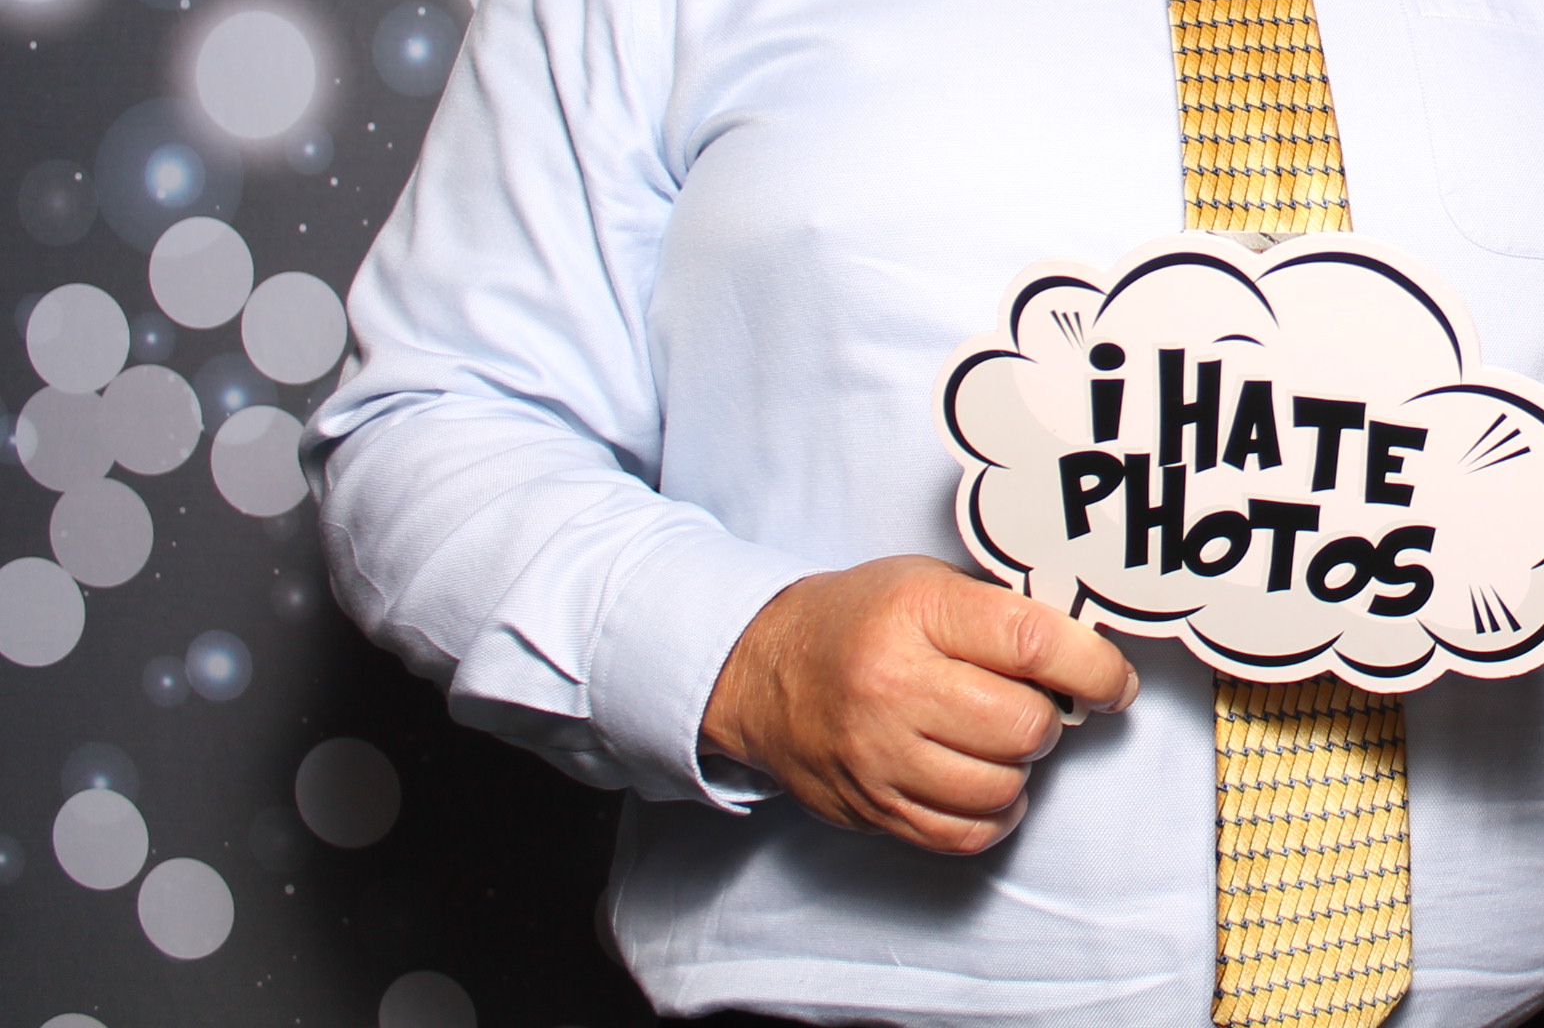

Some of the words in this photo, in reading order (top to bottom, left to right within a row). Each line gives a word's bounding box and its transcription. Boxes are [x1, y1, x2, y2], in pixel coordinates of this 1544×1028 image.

[1088, 342, 1126, 444] i
[1158, 347, 1429, 507] HATE
[1058, 450, 1437, 617] PHOTOS
